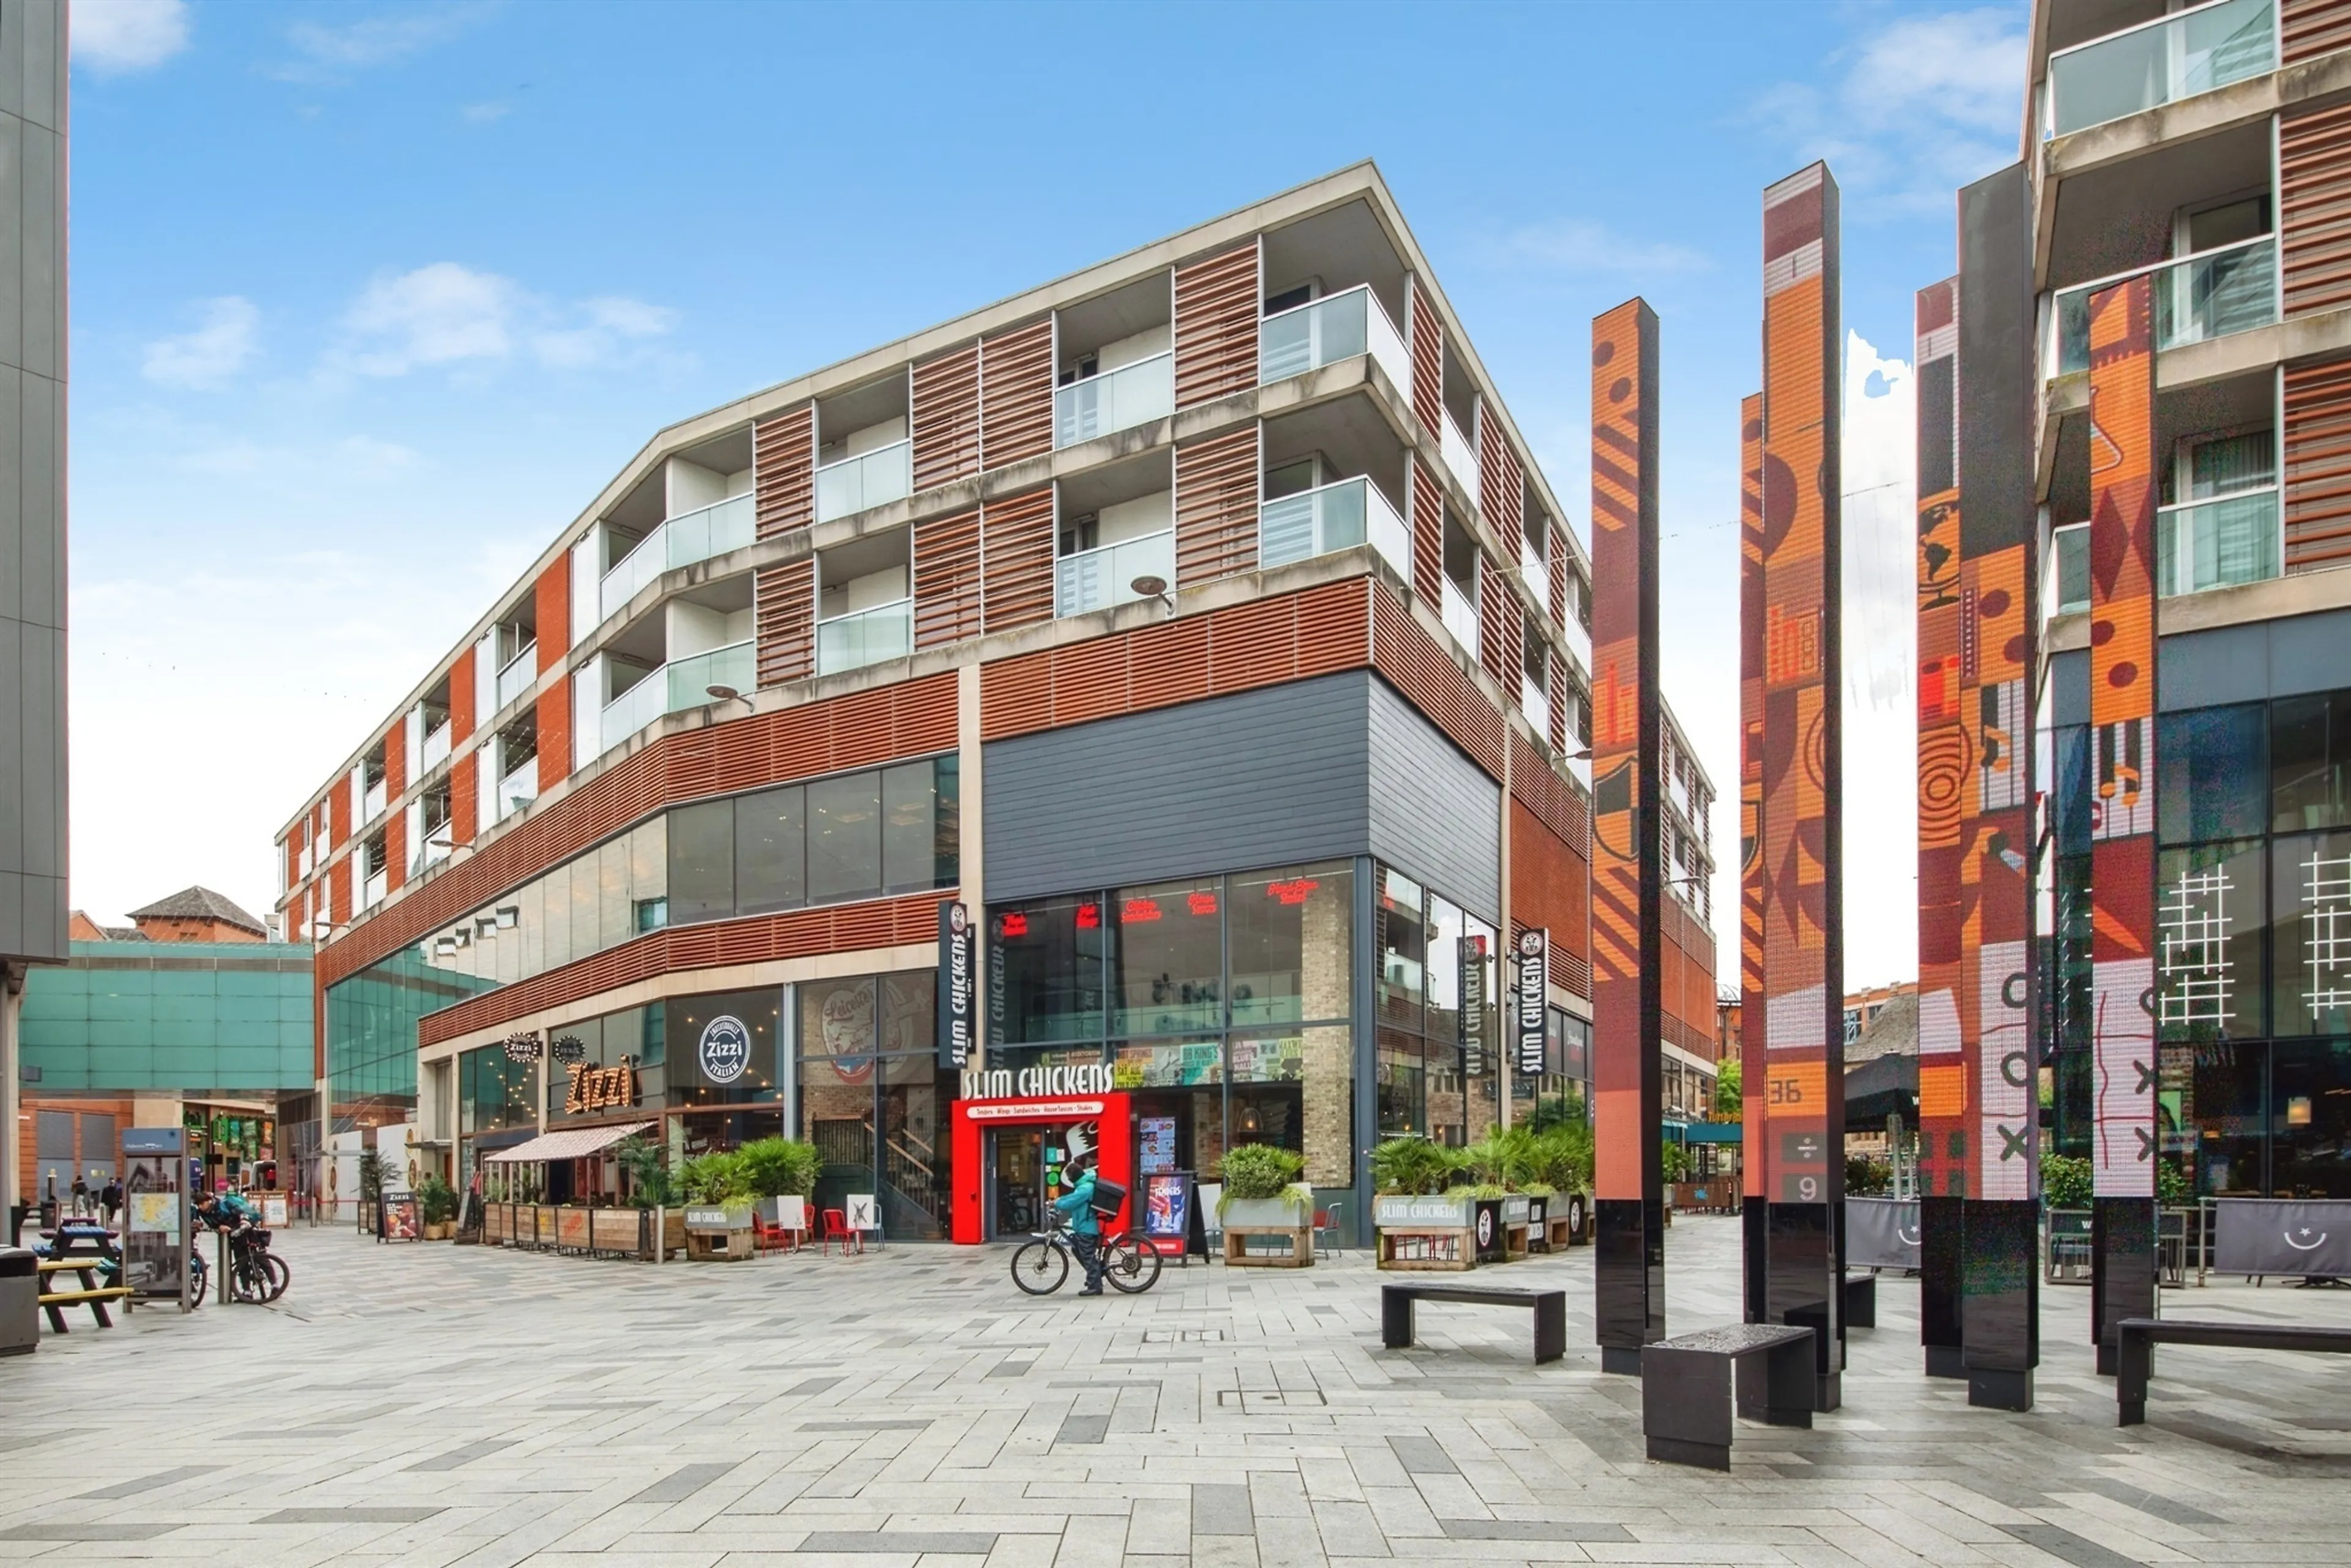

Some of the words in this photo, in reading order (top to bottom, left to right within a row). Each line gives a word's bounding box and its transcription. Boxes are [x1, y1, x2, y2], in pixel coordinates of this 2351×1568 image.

[951, 934, 966, 1014] CHICKENS
[1521, 957, 1542, 1029] CHICKENS
[707, 1041, 742, 1058] Zizzi
[952, 1020, 966, 1065] SLIM
[1521, 1033, 1542, 1072] SLIM
[565, 1054, 630, 1114] Zizzi
[710, 1062, 739, 1077] ITALIAN
[964, 1070, 1011, 1100] SLIM
[1018, 1062, 1115, 1097] CHICKENS
[1769, 1079, 1801, 1104] 36
[1799, 1176, 1817, 1201] 9
[1382, 1204, 1407, 1218] SLIM
[1410, 1204, 1458, 1218] CHICKENS
